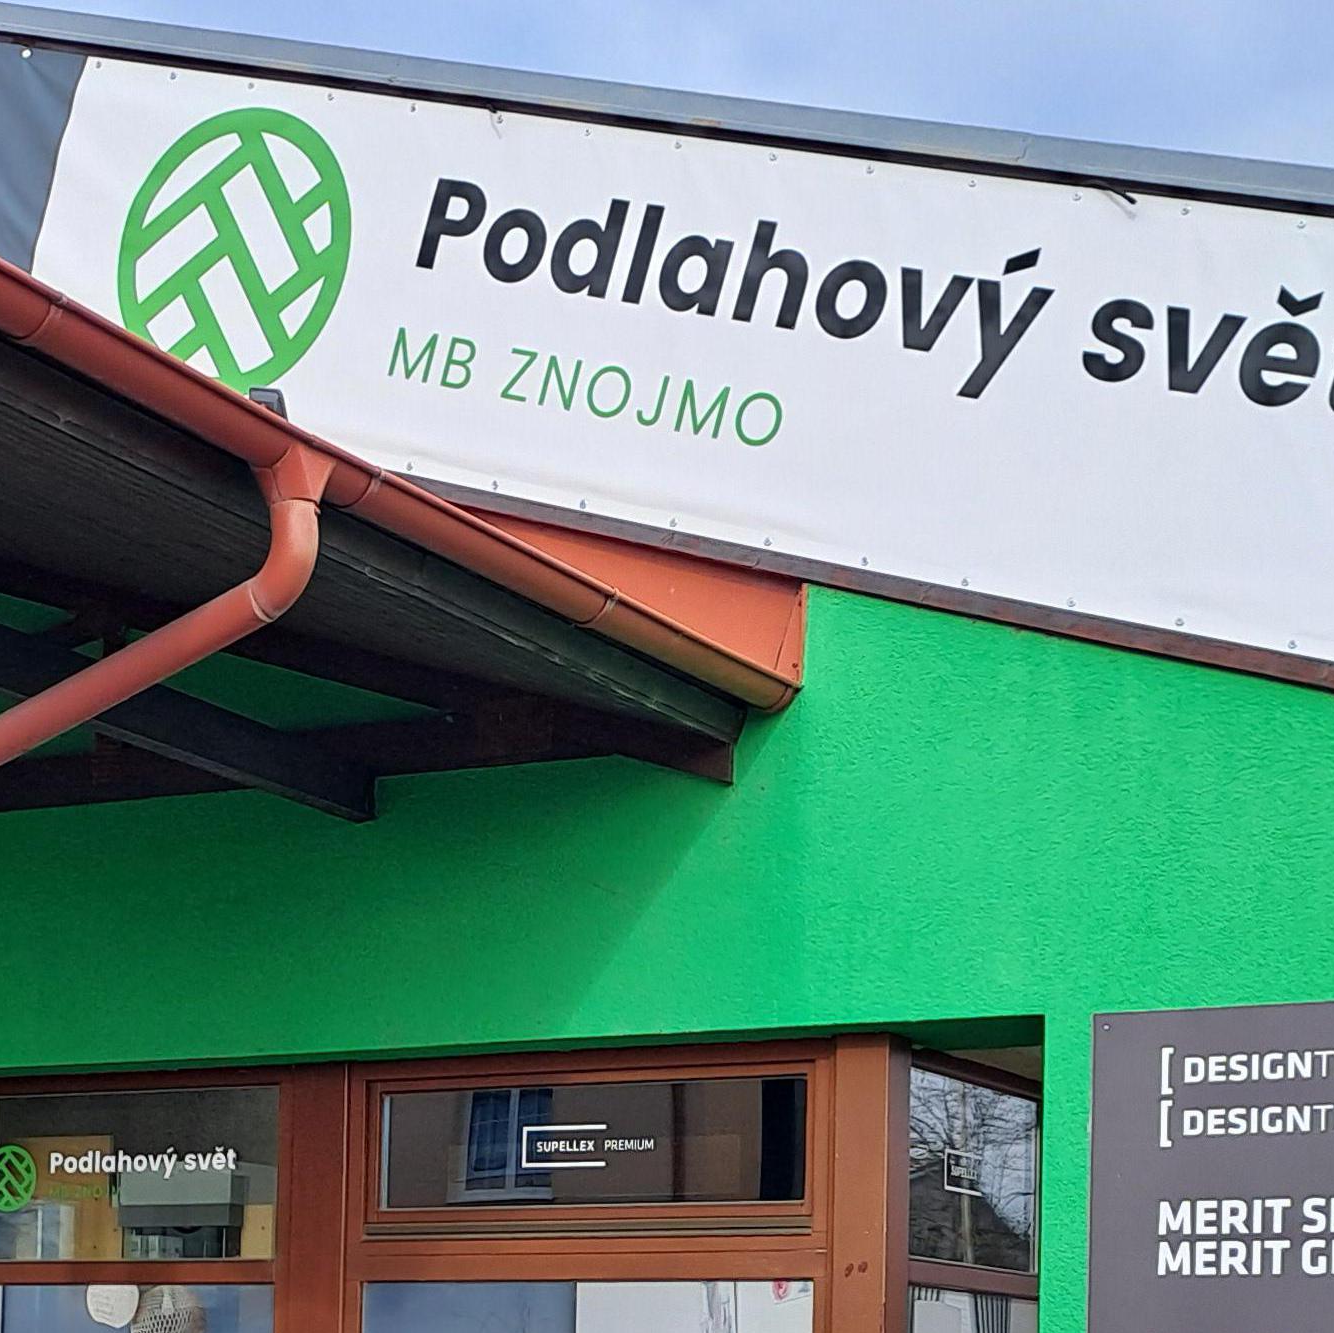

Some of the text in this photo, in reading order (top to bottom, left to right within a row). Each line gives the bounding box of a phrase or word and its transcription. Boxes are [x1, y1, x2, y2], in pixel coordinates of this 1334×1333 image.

[415, 178, 1054, 400] Podlahový
[387, 326, 783, 447] MB ZNOJMO
[49, 1147, 237, 1180] Podlahový svět
[536, 1138, 654, 1153] SUPELLEX PREMIUM
[1158, 1198, 1291, 1236] MERIT
[1157, 1239, 1291, 1276] MERIT
